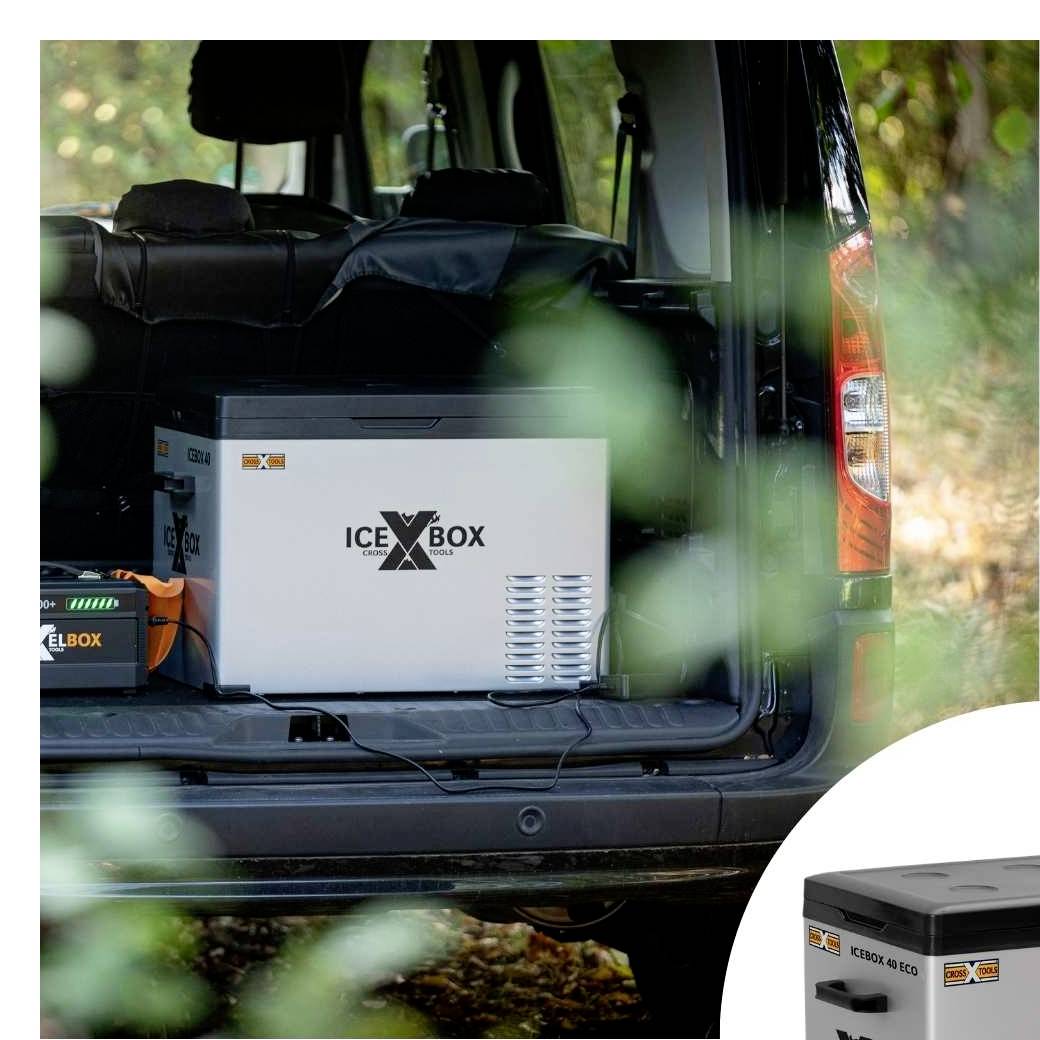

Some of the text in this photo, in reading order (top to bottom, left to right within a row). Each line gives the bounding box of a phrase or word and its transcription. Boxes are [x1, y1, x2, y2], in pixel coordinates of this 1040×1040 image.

[850, 945, 919, 977] ICEBOX 40 ECO
[945, 969, 967, 980] CROSS
[978, 964, 998, 975] TOOLS
